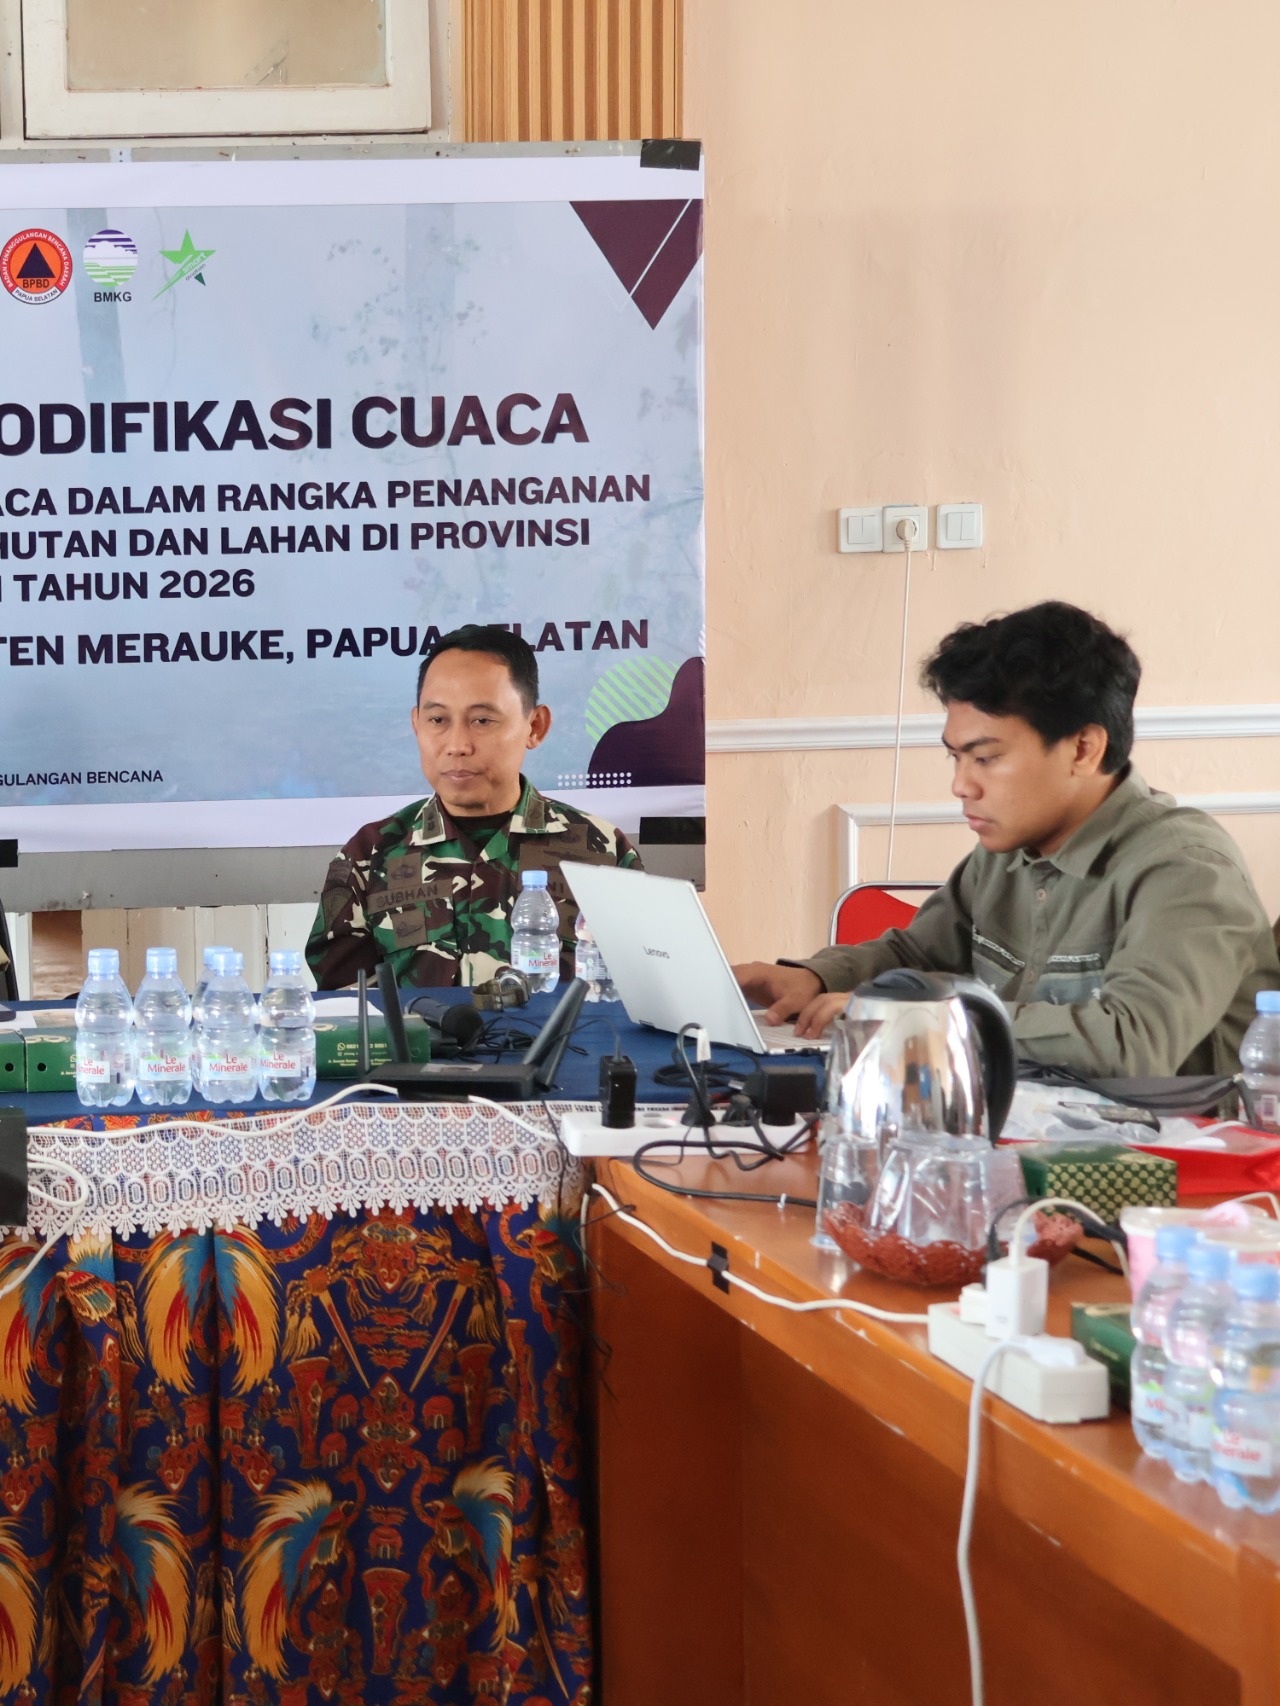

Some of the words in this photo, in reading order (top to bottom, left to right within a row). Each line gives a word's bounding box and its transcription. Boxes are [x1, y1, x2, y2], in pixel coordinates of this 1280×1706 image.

[22, 279, 50, 288] BPBD
[94, 292, 131, 302] BMKG
[352, 393, 589, 449] CUACA
[69, 485, 204, 514] DALAM
[218, 482, 371, 511] RANGKA
[388, 475, 649, 508] PENANGANAN
[130, 528, 208, 556] DAN
[221, 525, 350, 554] LAHAN
[363, 524, 398, 551] DI
[411, 519, 589, 549] PROVINSI
[13, 572, 147, 601] TAHUN
[160, 569, 254, 598] 2026
[78, 630, 293, 664] MERAUKE,
[307, 626, 442, 658] PAPUA
[87, 770, 163, 784] BENCANA
[377, 884, 438, 908] SUBHAN
[543, 952, 552, 961] Le
[84, 1056, 93, 1066] Le
[165, 1054, 177, 1065] Le
[226, 1053, 237, 1064] Le
[273, 1051, 284, 1061] Le
[147, 1062, 186, 1073] Minerale
[209, 1062, 248, 1072] Minerale
[260, 1058, 296, 1069] Minerale
